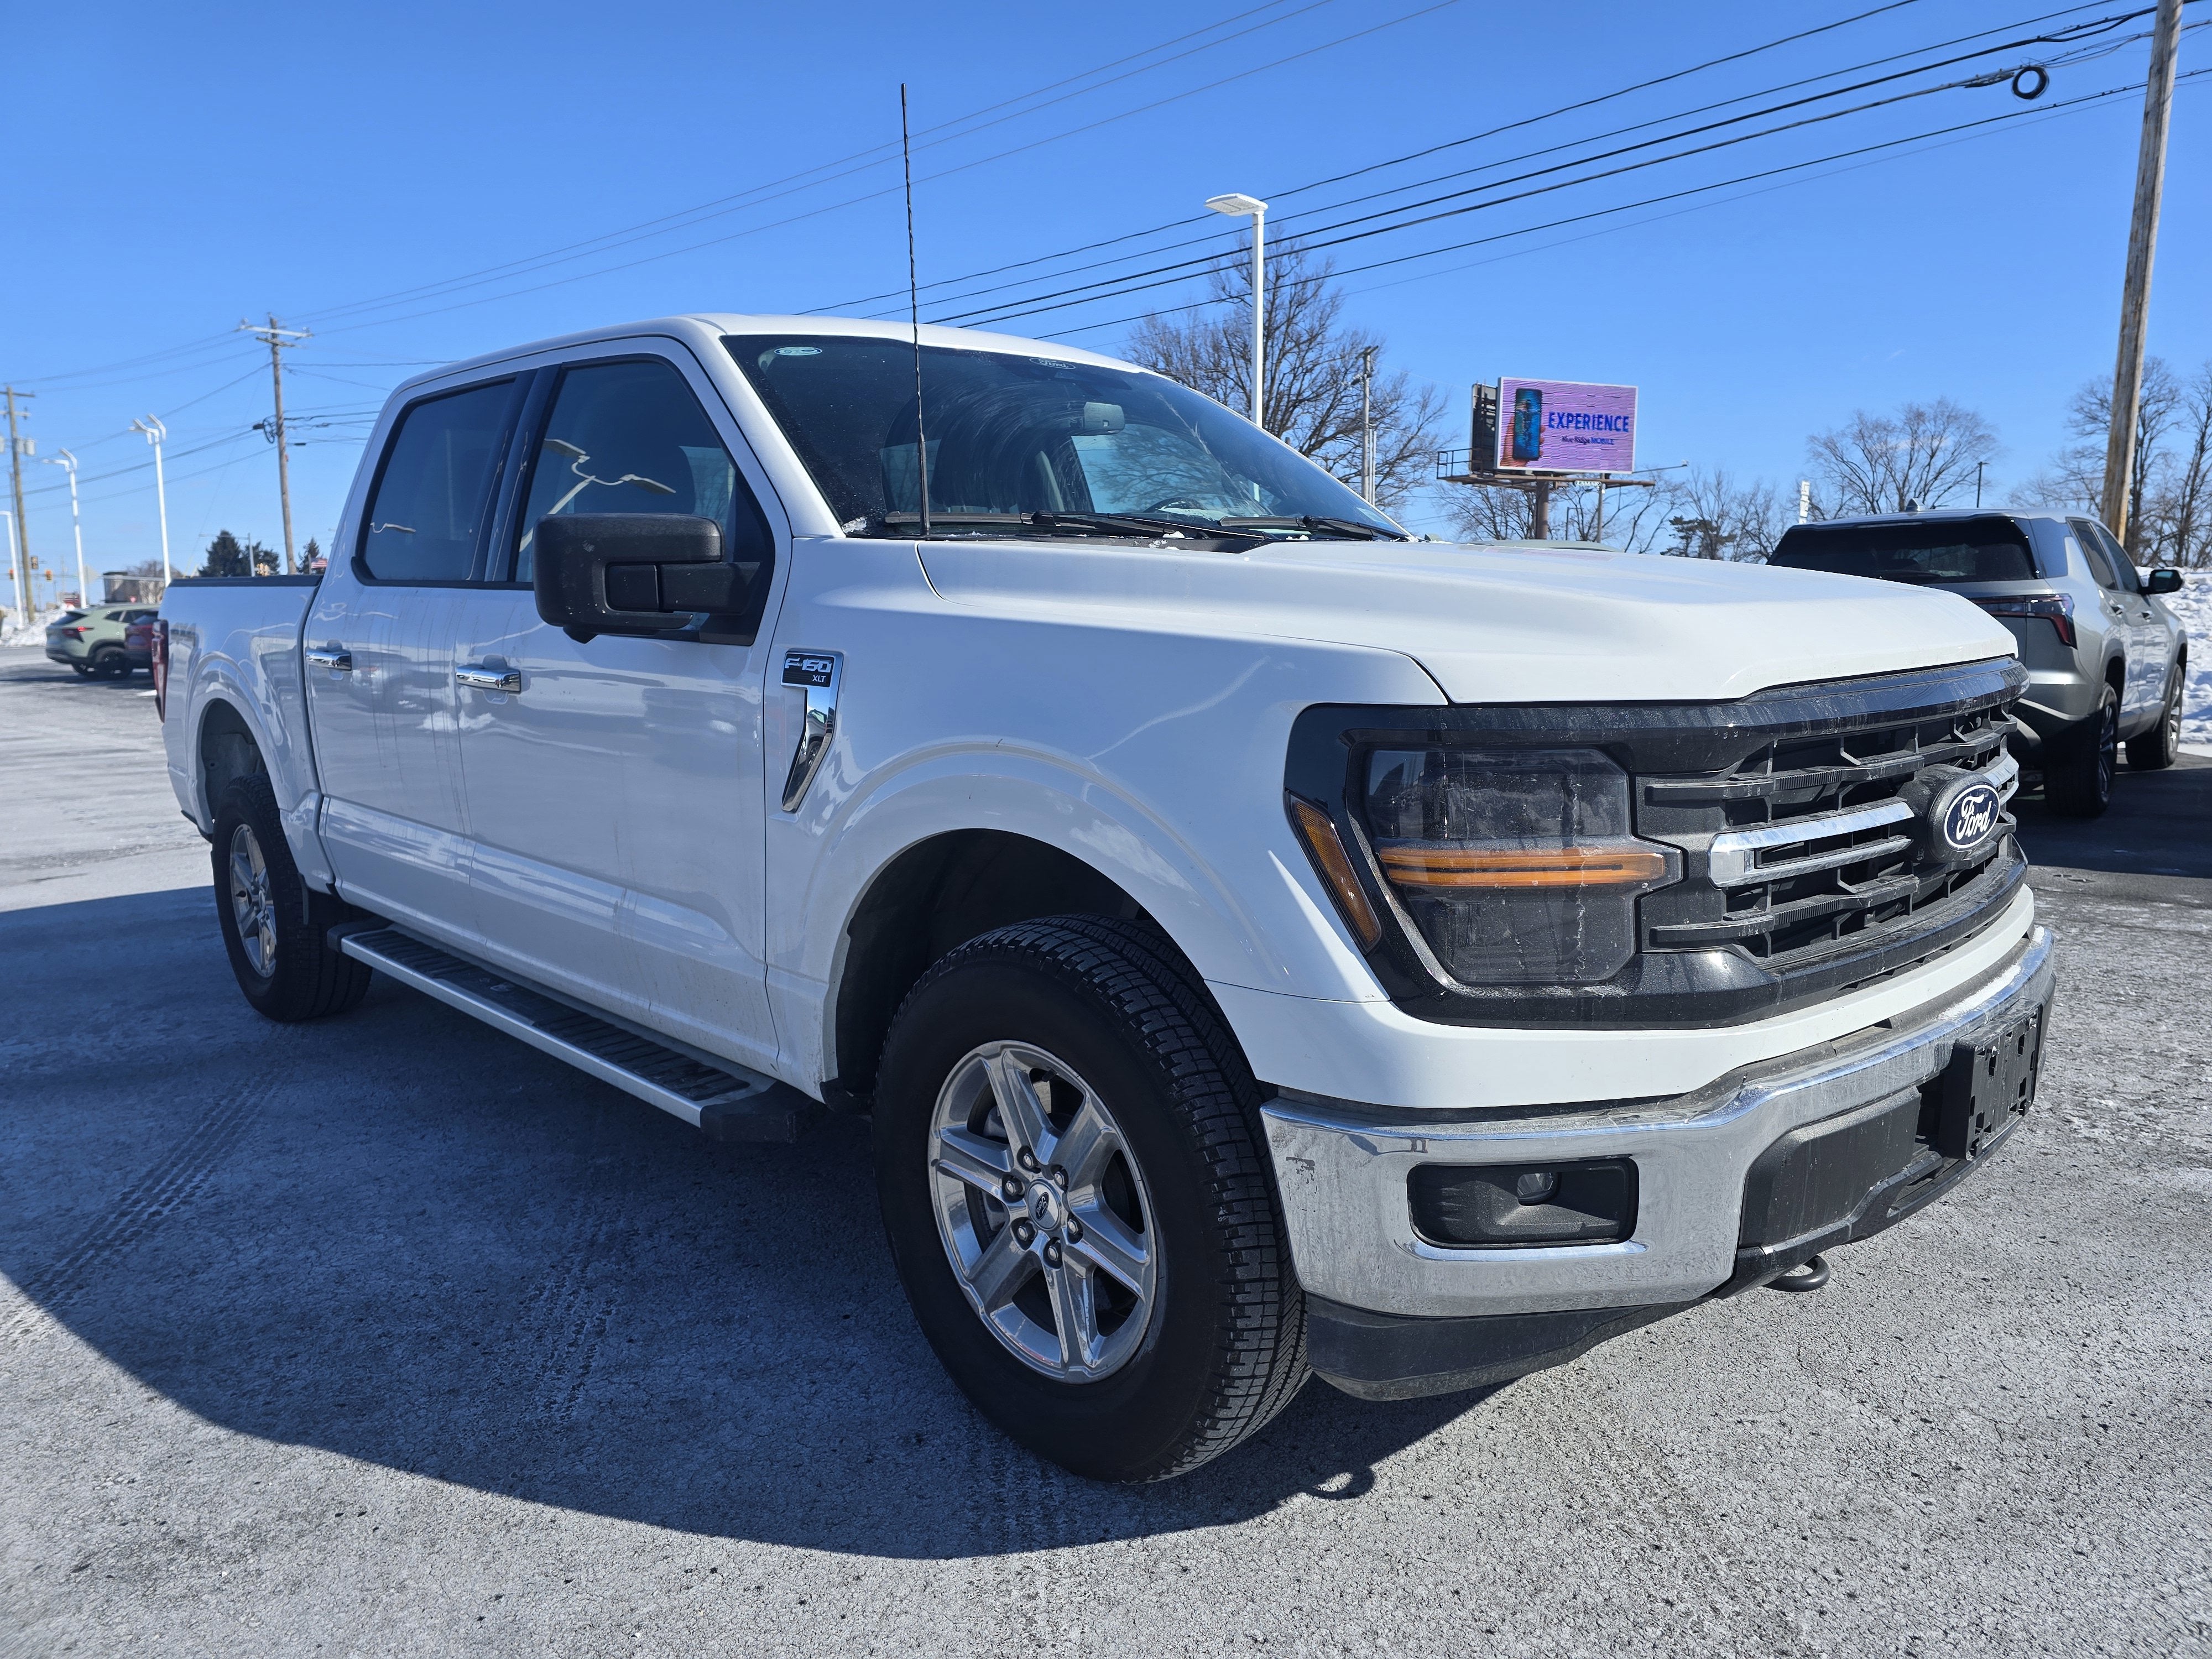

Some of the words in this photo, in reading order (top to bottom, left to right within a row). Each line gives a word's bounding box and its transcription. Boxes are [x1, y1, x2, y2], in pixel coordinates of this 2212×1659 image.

[1039, 358, 1068, 368] Ford
[1549, 411, 1629, 432] EXPERIENCE
[785, 658, 832, 672] F-150
[1956, 794, 1992, 841] Ford
[1036, 1196, 1047, 1217] Ford
